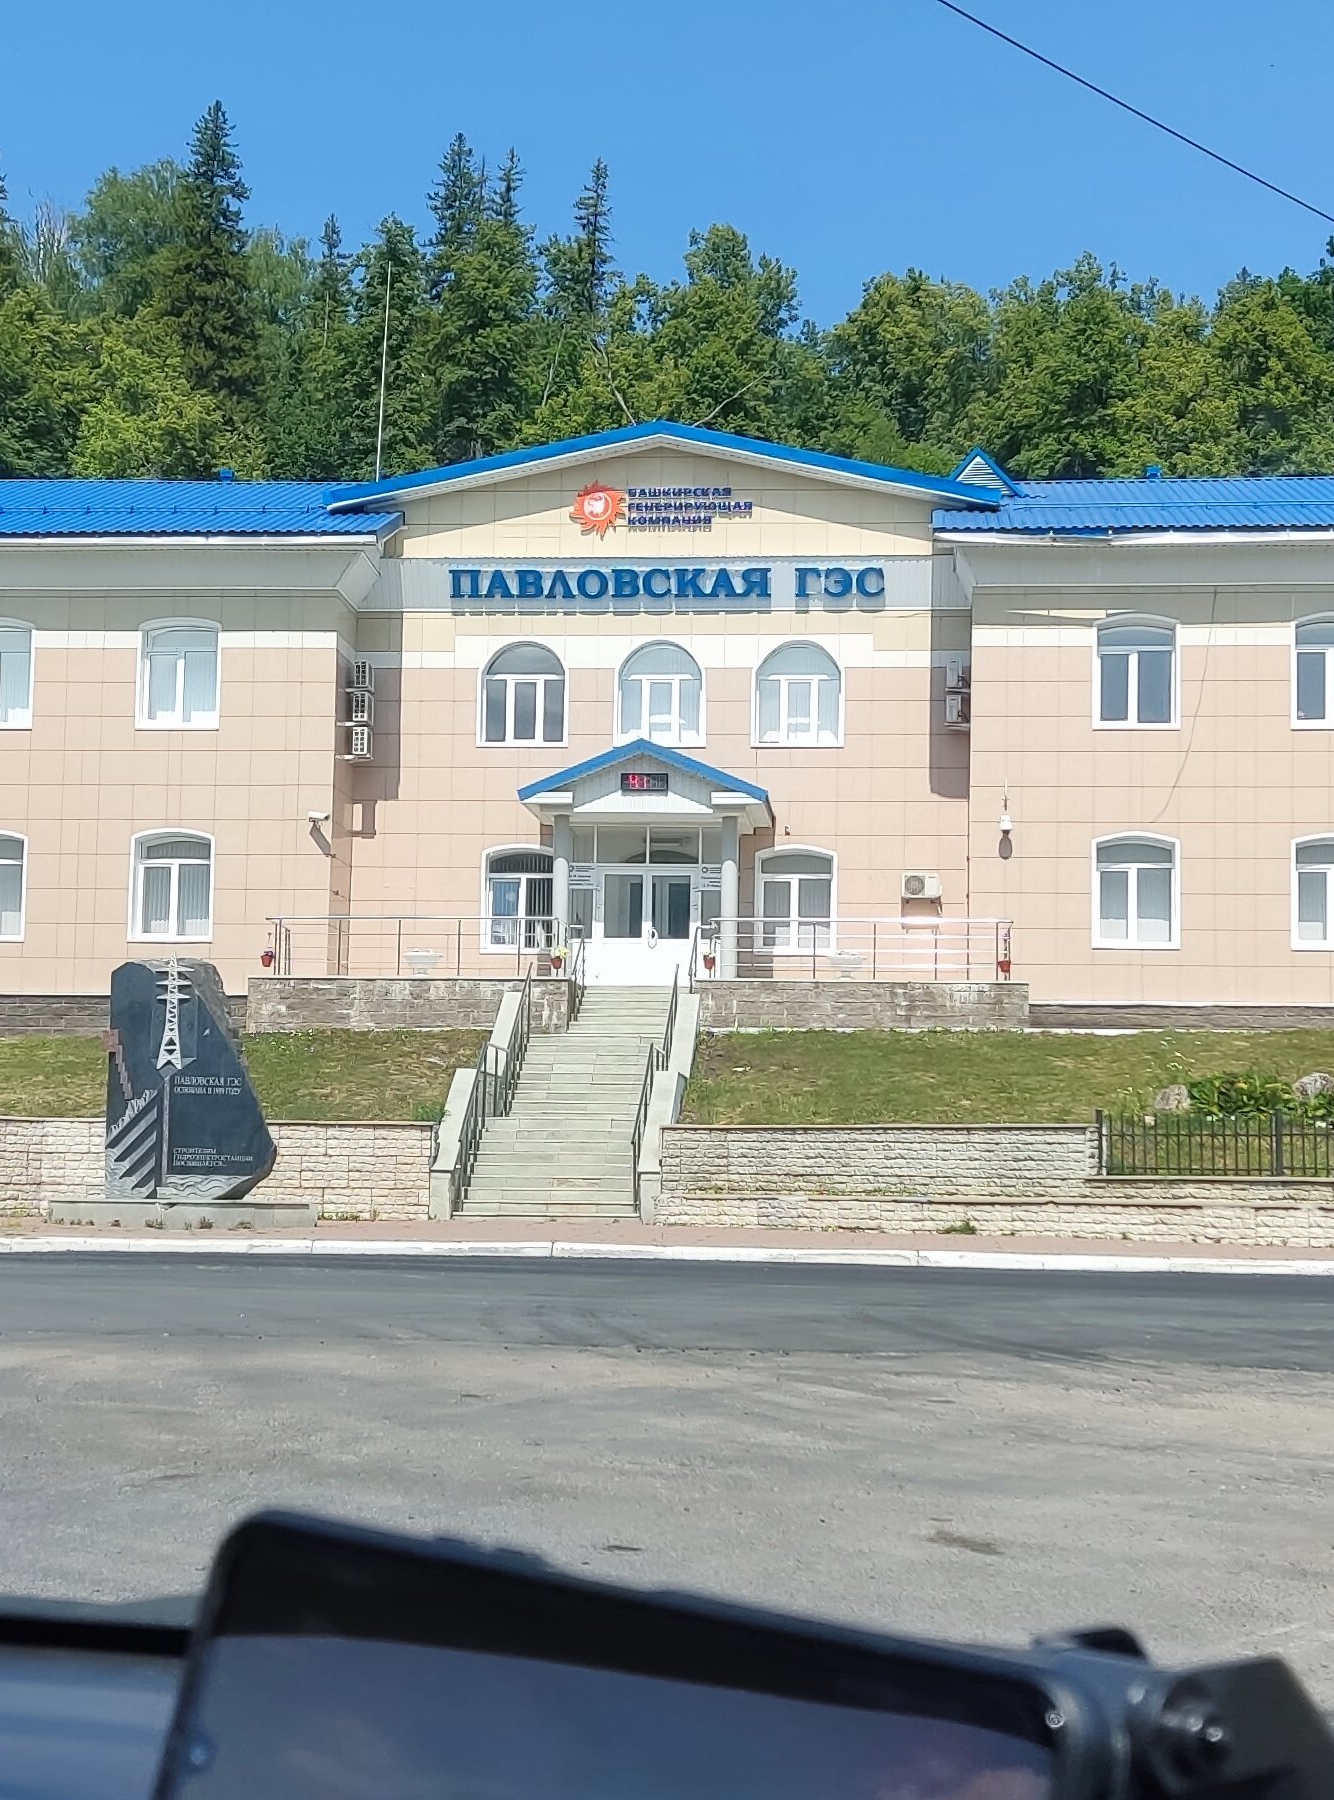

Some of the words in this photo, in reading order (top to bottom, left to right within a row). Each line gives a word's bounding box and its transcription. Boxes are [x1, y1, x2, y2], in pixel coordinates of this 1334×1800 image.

[628, 487, 732, 498] БАШКИРСКАЯ
[628, 501, 753, 513] ГЕНЕРИРУЮЩАЯ
[628, 515, 712, 526] КОМПАНИЯ
[449, 568, 771, 599] ПАВЛОВСКАЯ
[795, 567, 886, 598] ГЭС
[174, 1076, 224, 1086] ПАВЛОВСКАЯ
